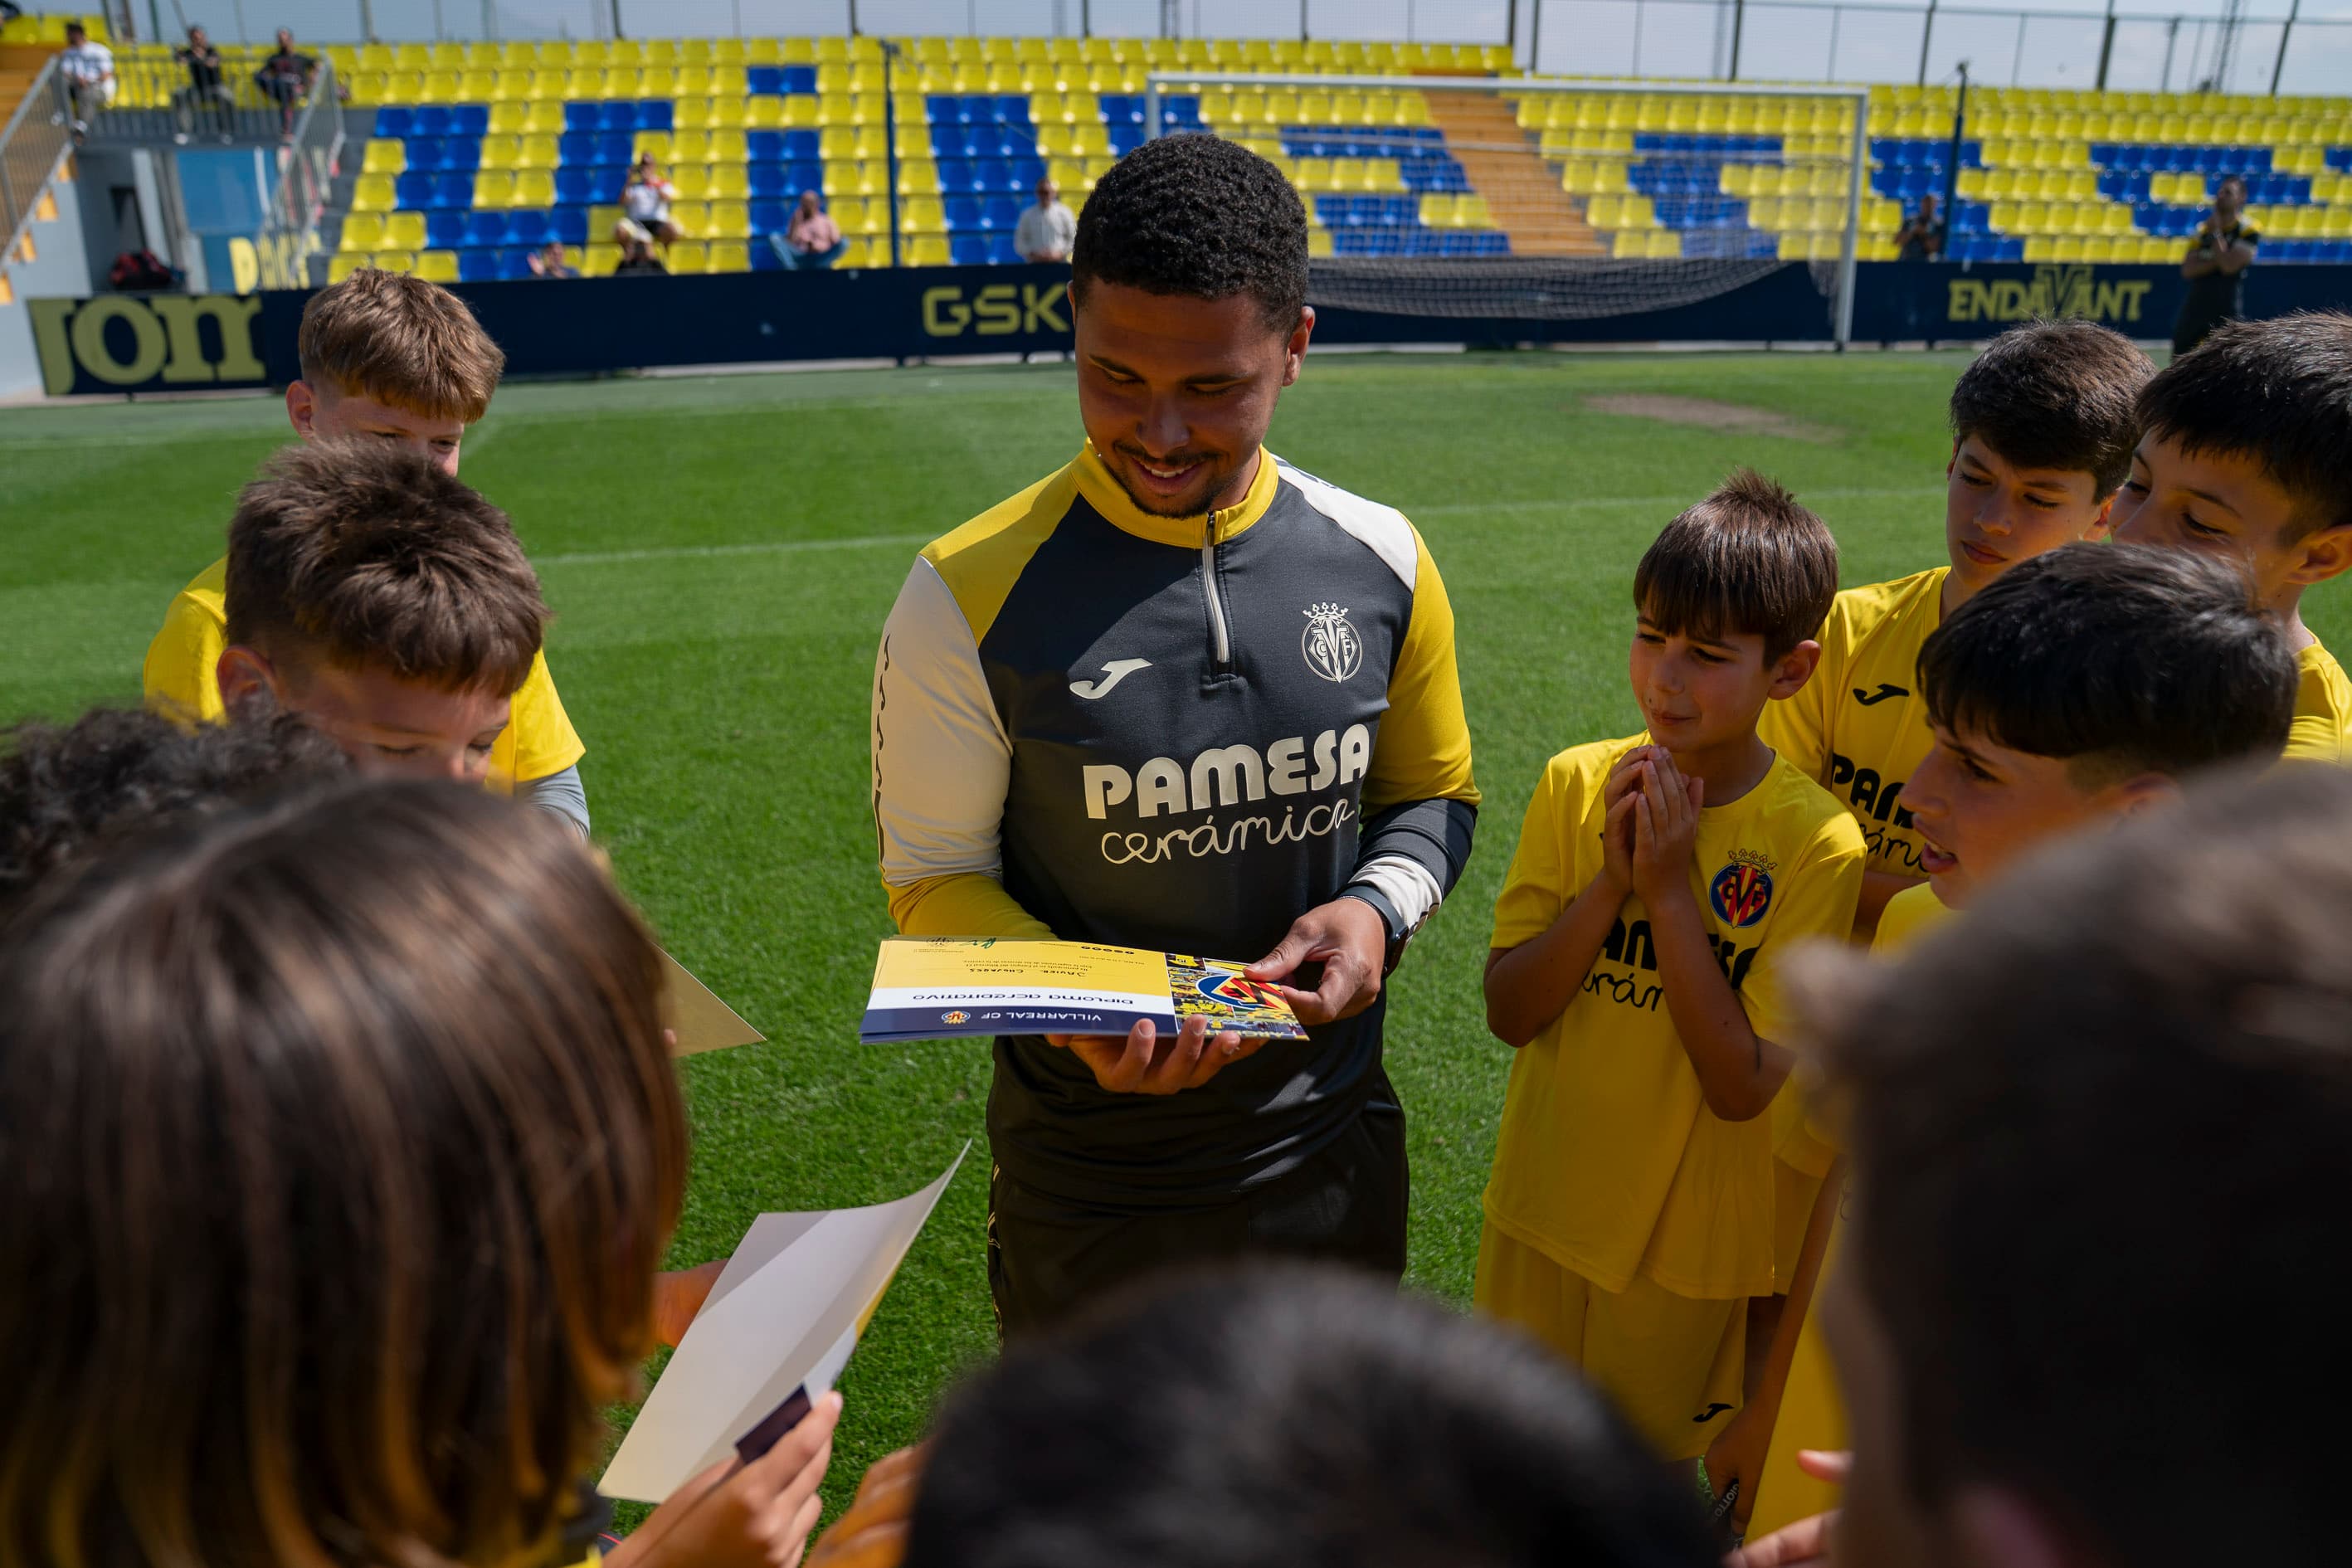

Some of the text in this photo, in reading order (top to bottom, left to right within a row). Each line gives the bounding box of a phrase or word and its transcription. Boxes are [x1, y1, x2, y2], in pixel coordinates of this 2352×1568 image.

[922, 283, 1070, 337] GSK
[1947, 264, 2154, 322] ENDAVANT
[1082, 723, 1370, 820] PAMESA
[1101, 798, 1356, 864] cerámica
[1006, 1011, 1102, 1021] VILLARREAL
